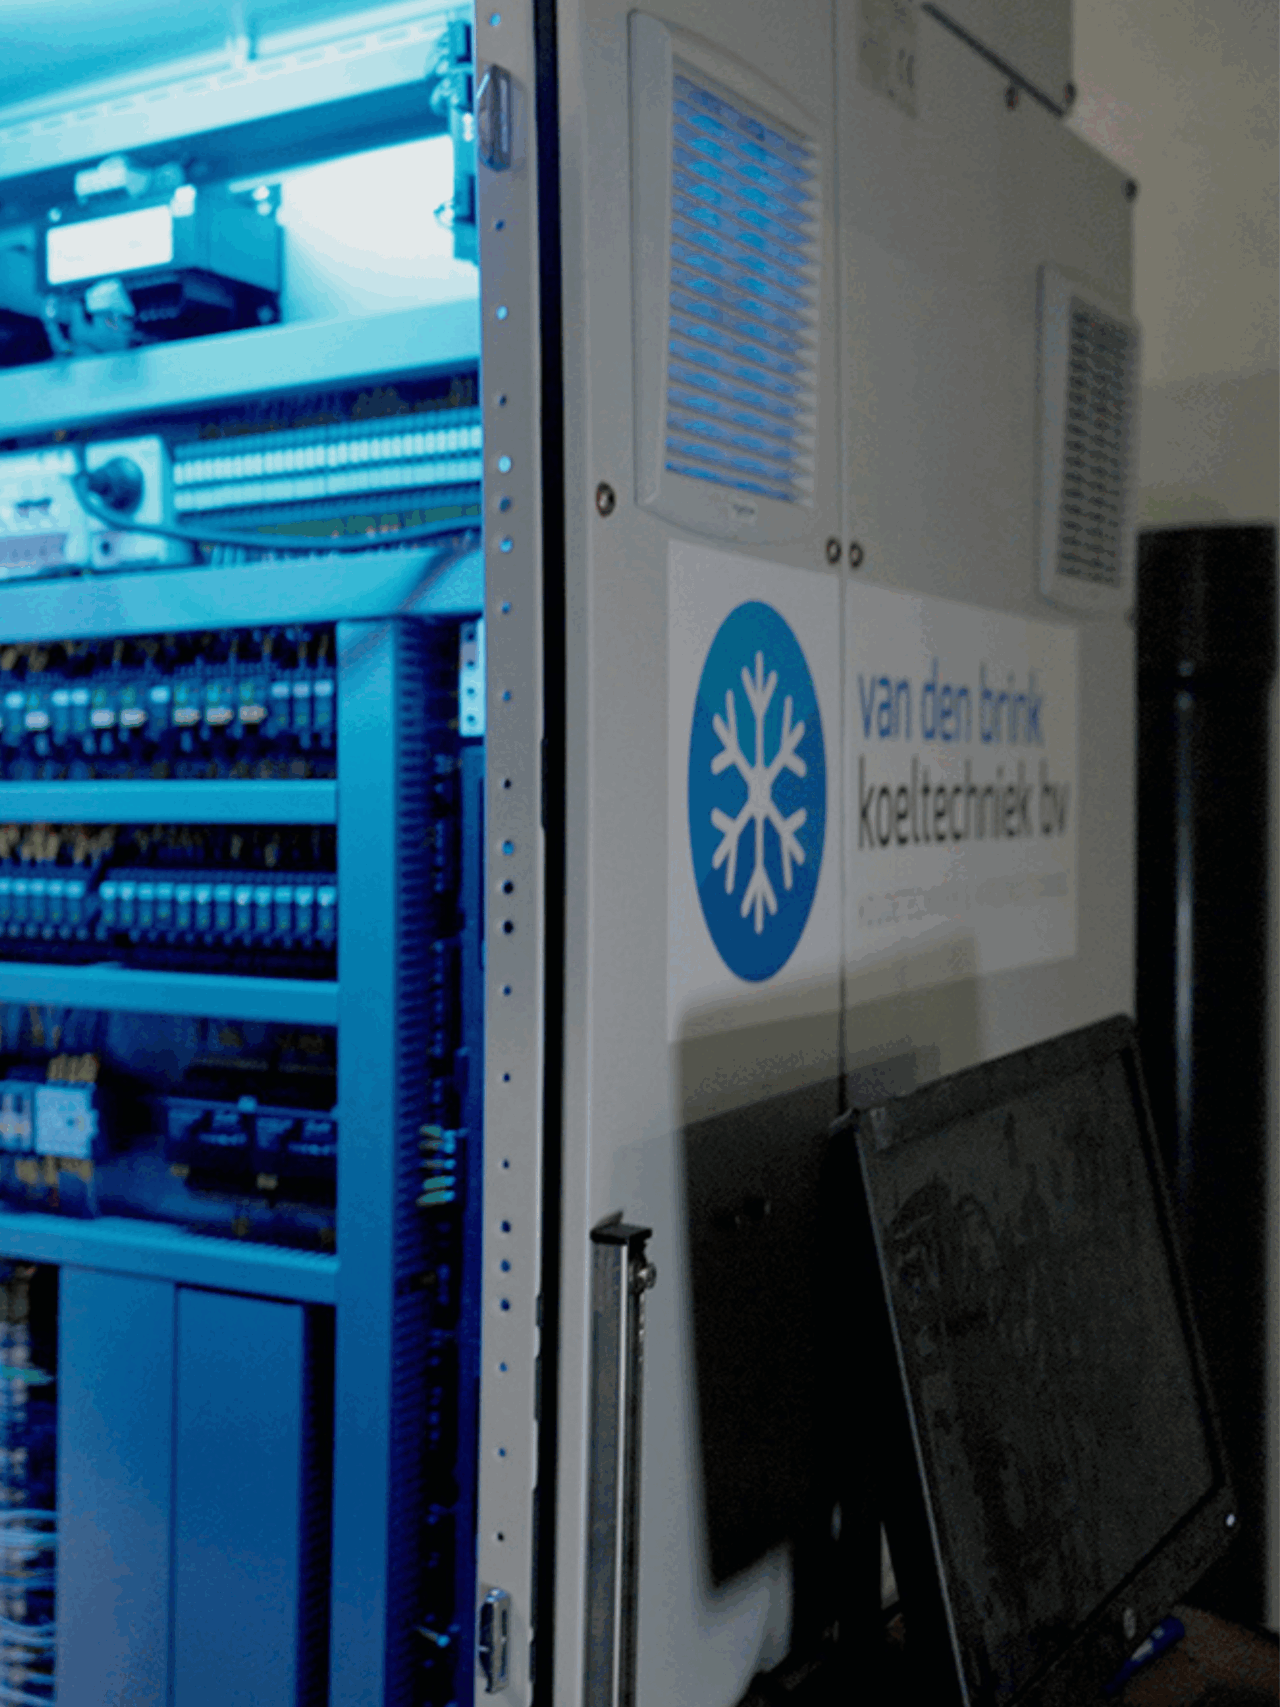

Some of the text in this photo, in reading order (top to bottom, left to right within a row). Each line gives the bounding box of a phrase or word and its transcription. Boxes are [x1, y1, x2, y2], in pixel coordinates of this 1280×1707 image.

[858, 657, 1045, 748] van den brink
[857, 754, 1071, 850] koeltechniek bv
